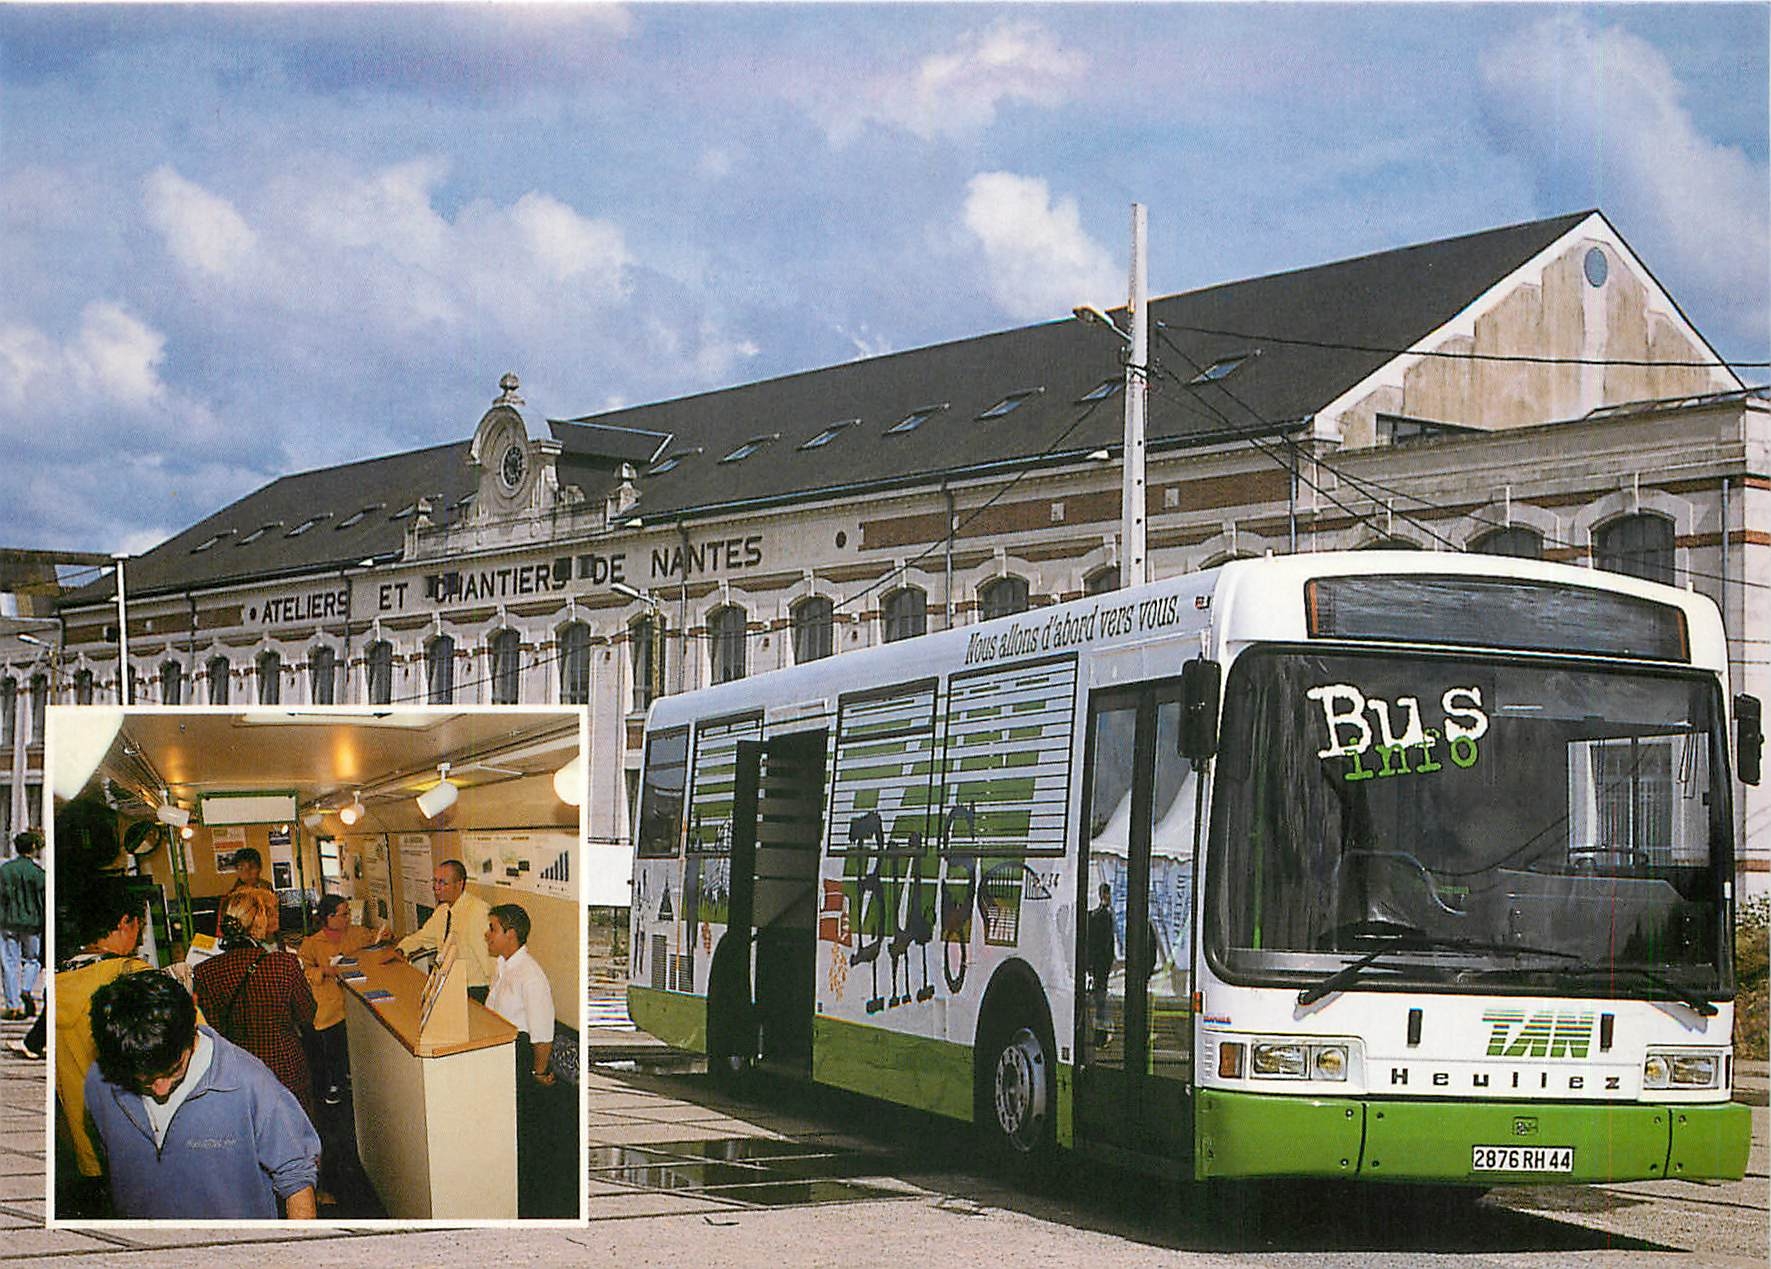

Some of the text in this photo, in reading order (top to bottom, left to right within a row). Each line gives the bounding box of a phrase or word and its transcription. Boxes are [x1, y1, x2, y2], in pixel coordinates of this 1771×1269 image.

[262, 590, 348, 624] ATELIERS
[379, 582, 408, 610] ET
[593, 554, 626, 584] DE
[650, 536, 763, 579] NANTES
[964, 594, 1180, 665] Nous allons d'abord vers vous.
[1306, 684, 1490, 760] Bus
[1344, 727, 1479, 781] info
[1482, 1009, 1595, 1058] TAN
[1474, 1149, 1570, 1170] 2876 RH 44
